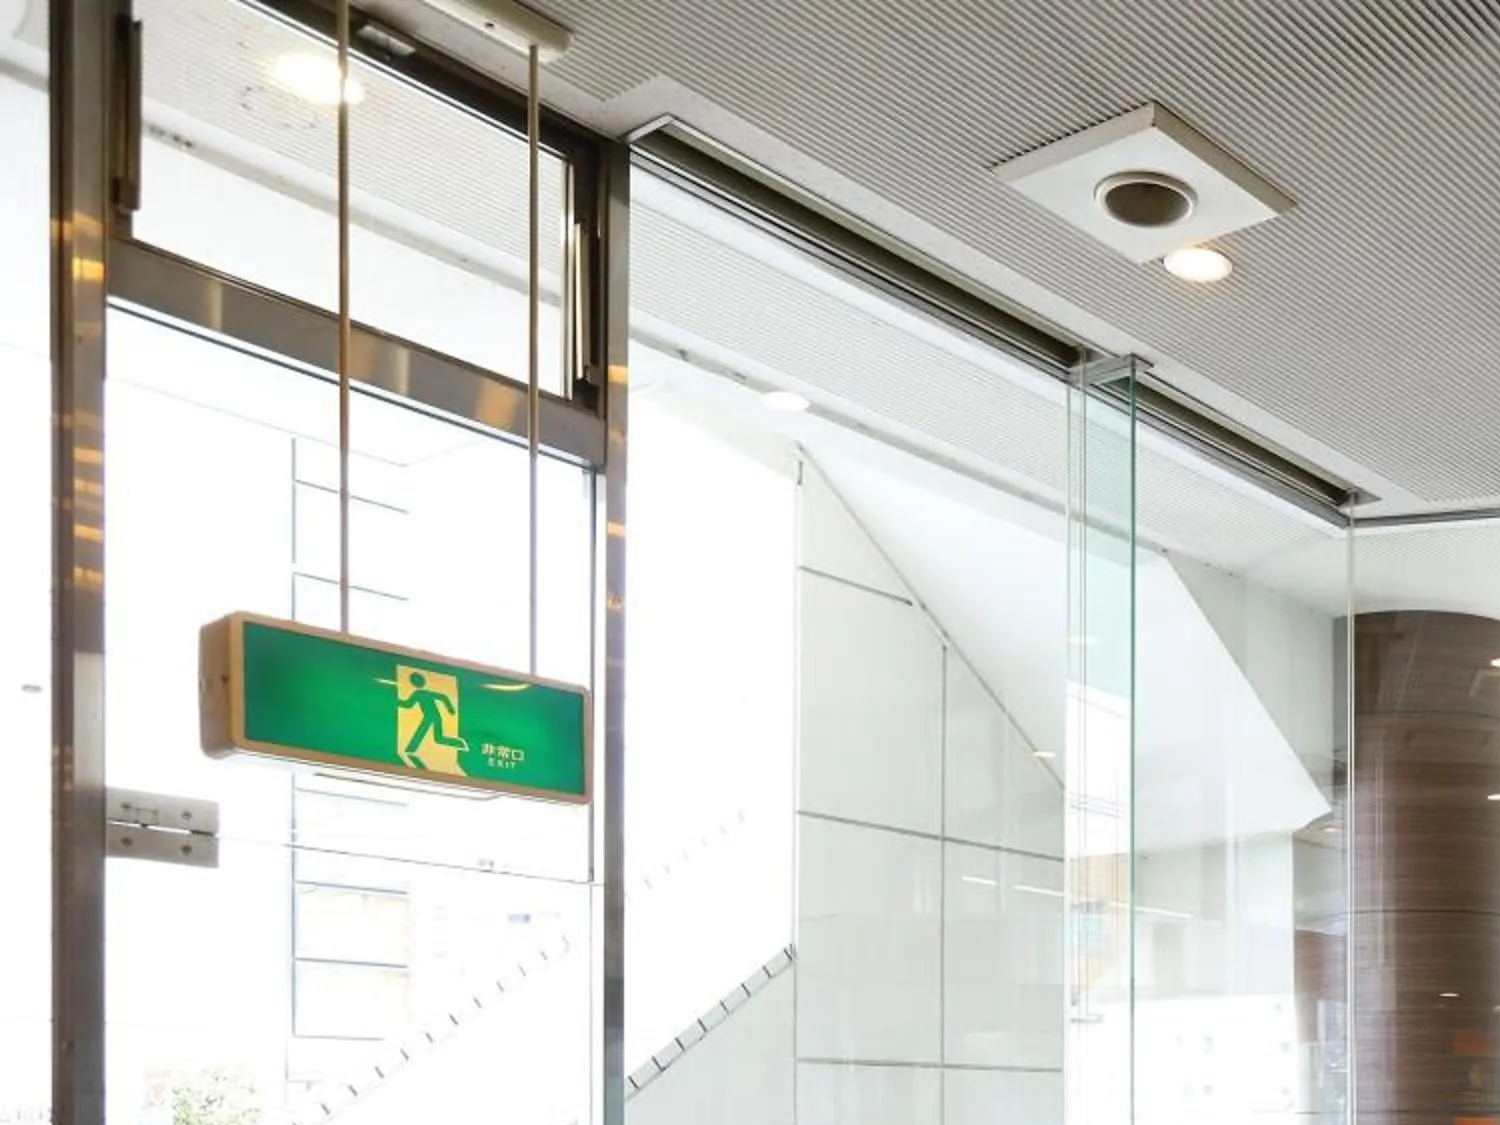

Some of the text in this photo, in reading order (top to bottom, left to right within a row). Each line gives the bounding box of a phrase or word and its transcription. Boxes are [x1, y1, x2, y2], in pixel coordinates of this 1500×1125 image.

[481, 743, 525, 761] 非常口
[488, 757, 517, 769] EXIT
